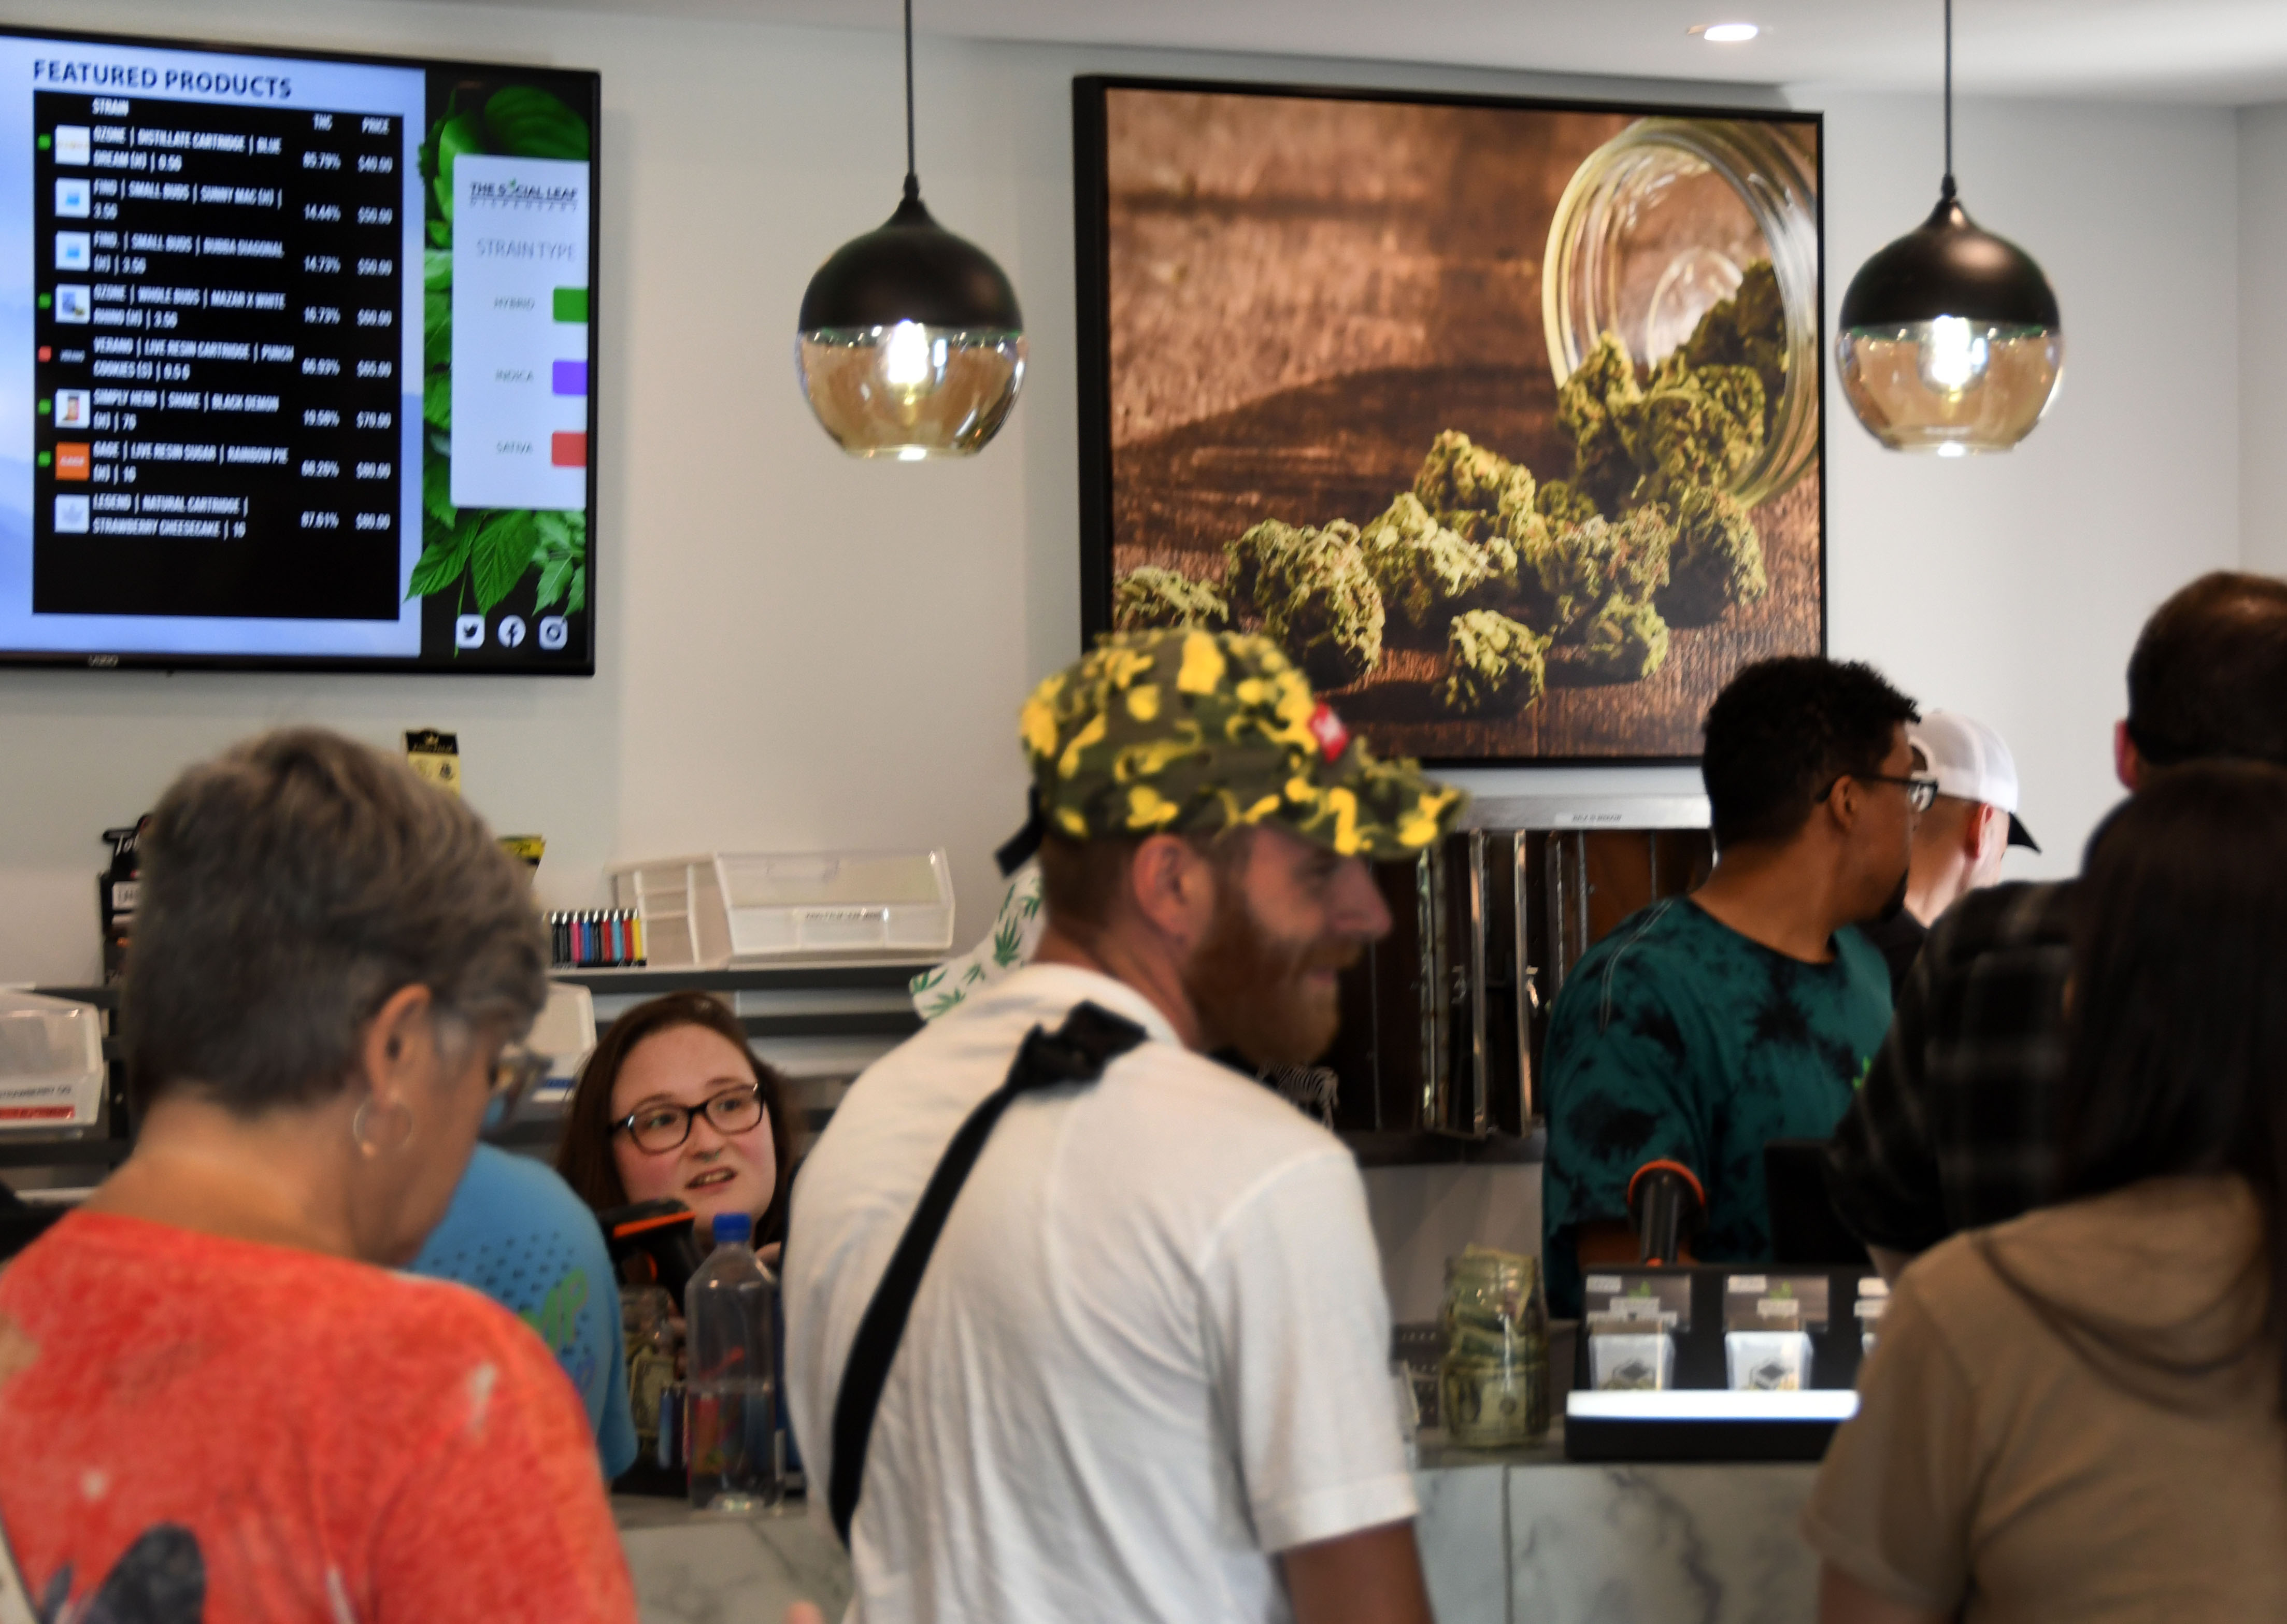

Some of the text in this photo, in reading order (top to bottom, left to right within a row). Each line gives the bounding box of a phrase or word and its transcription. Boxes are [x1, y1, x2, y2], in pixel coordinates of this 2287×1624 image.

[34, 59, 292, 99] FEATURED PRODUCTS
[92, 95, 129, 117] STRAIN
[470, 181, 495, 197] THE
[547, 187, 578, 201] LEAF
[477, 238, 575, 262] STRAIN TYPE
